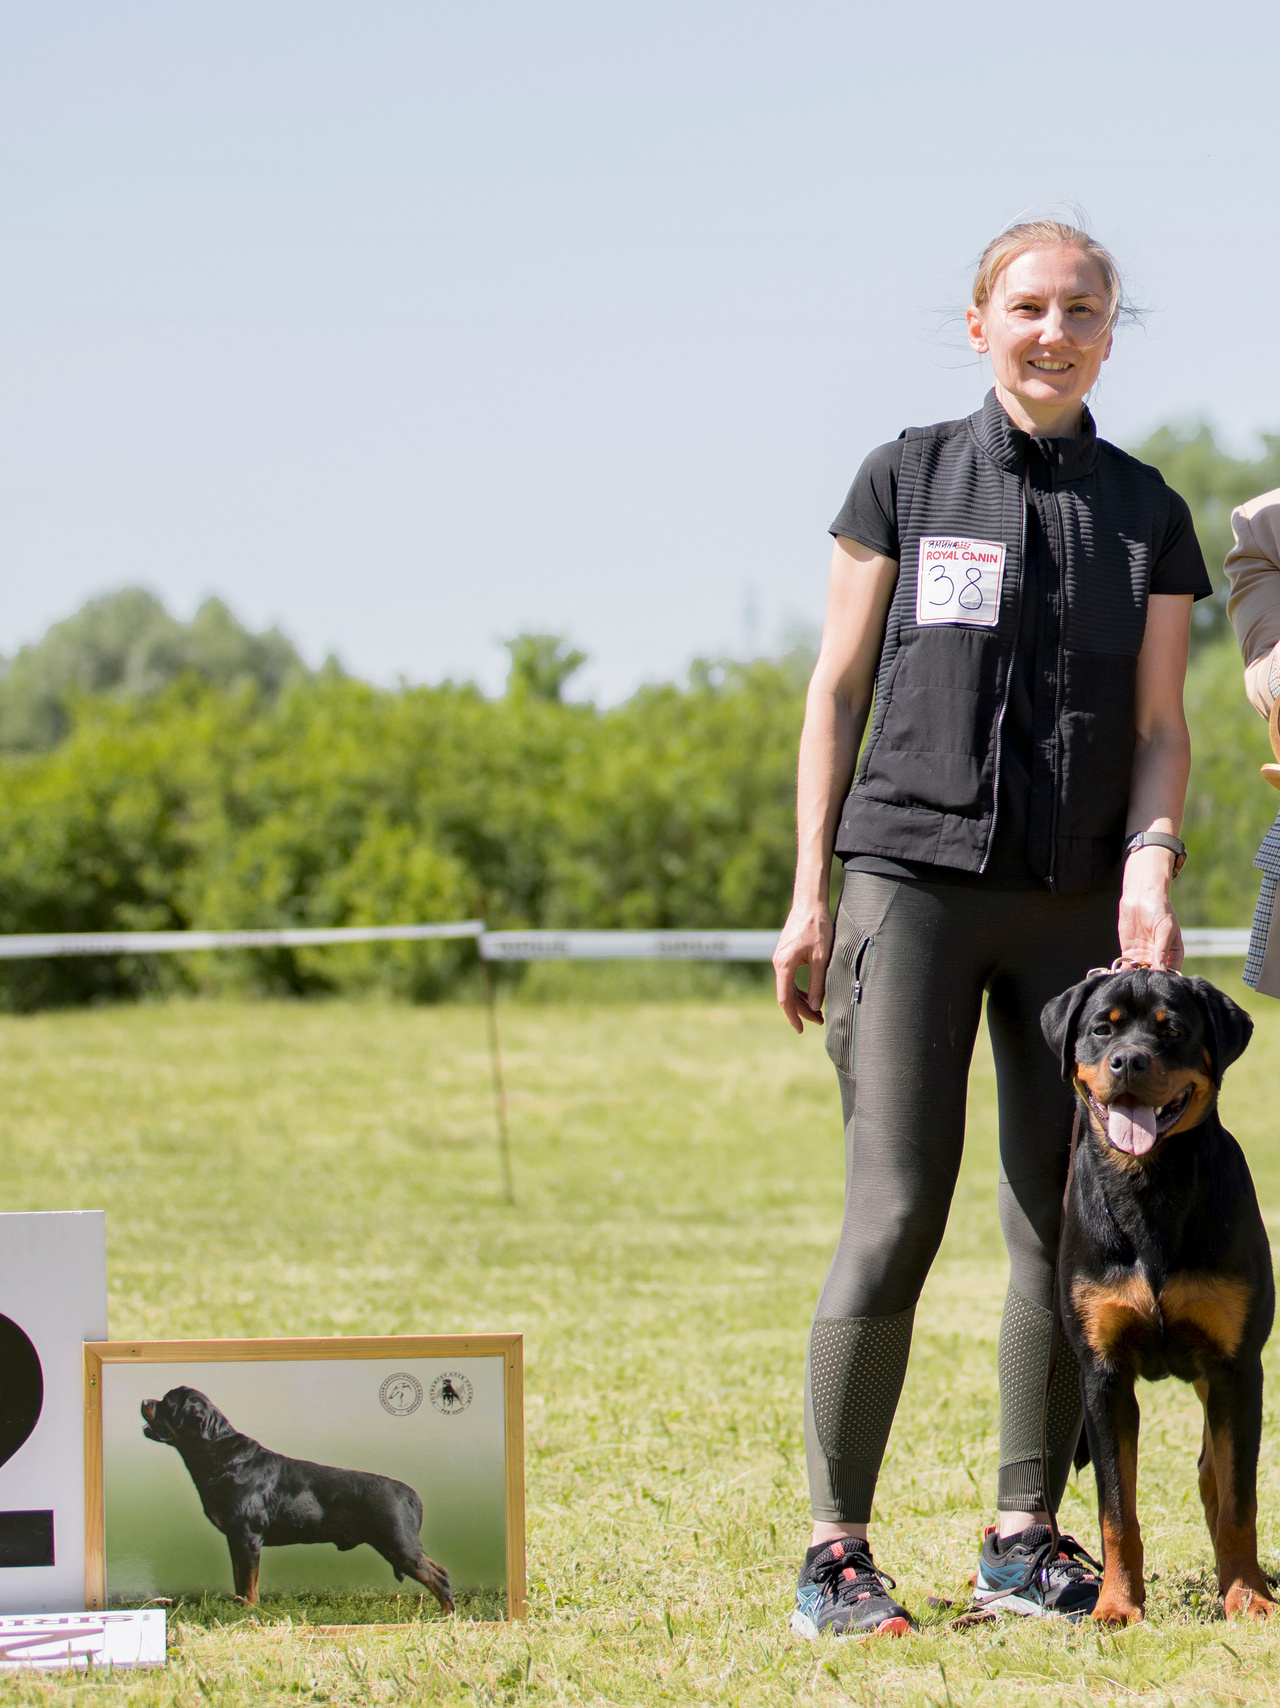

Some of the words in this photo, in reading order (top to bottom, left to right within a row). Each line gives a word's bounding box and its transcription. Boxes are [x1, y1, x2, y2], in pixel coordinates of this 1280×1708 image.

[926, 550, 959, 560] ROYAL
[962, 551, 998, 563] CANIN
[928, 565, 983, 610] 38
